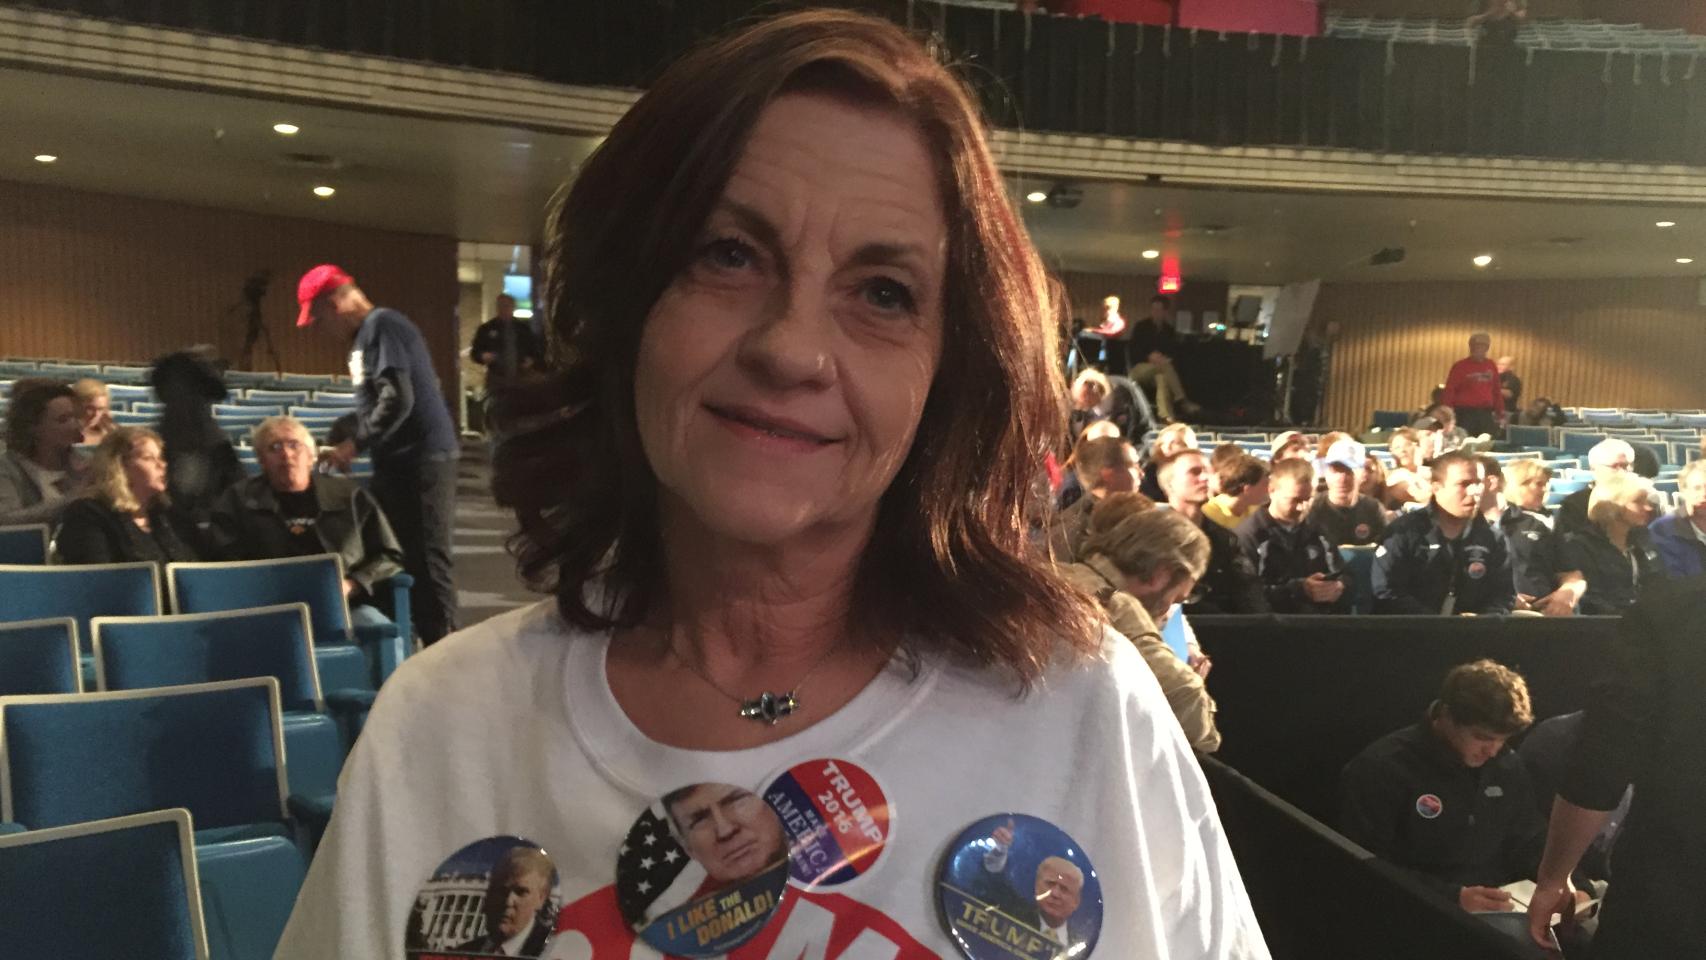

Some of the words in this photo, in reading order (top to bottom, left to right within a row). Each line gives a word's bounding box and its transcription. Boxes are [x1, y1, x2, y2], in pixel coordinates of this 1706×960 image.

[818, 790, 853, 834] 2016
[822, 760, 883, 844] TRUMP
[667, 920, 676, 940] I
[677, 898, 718, 935] LIKE
[719, 890, 741, 910] THE
[696, 890, 774, 946] DONALD!
